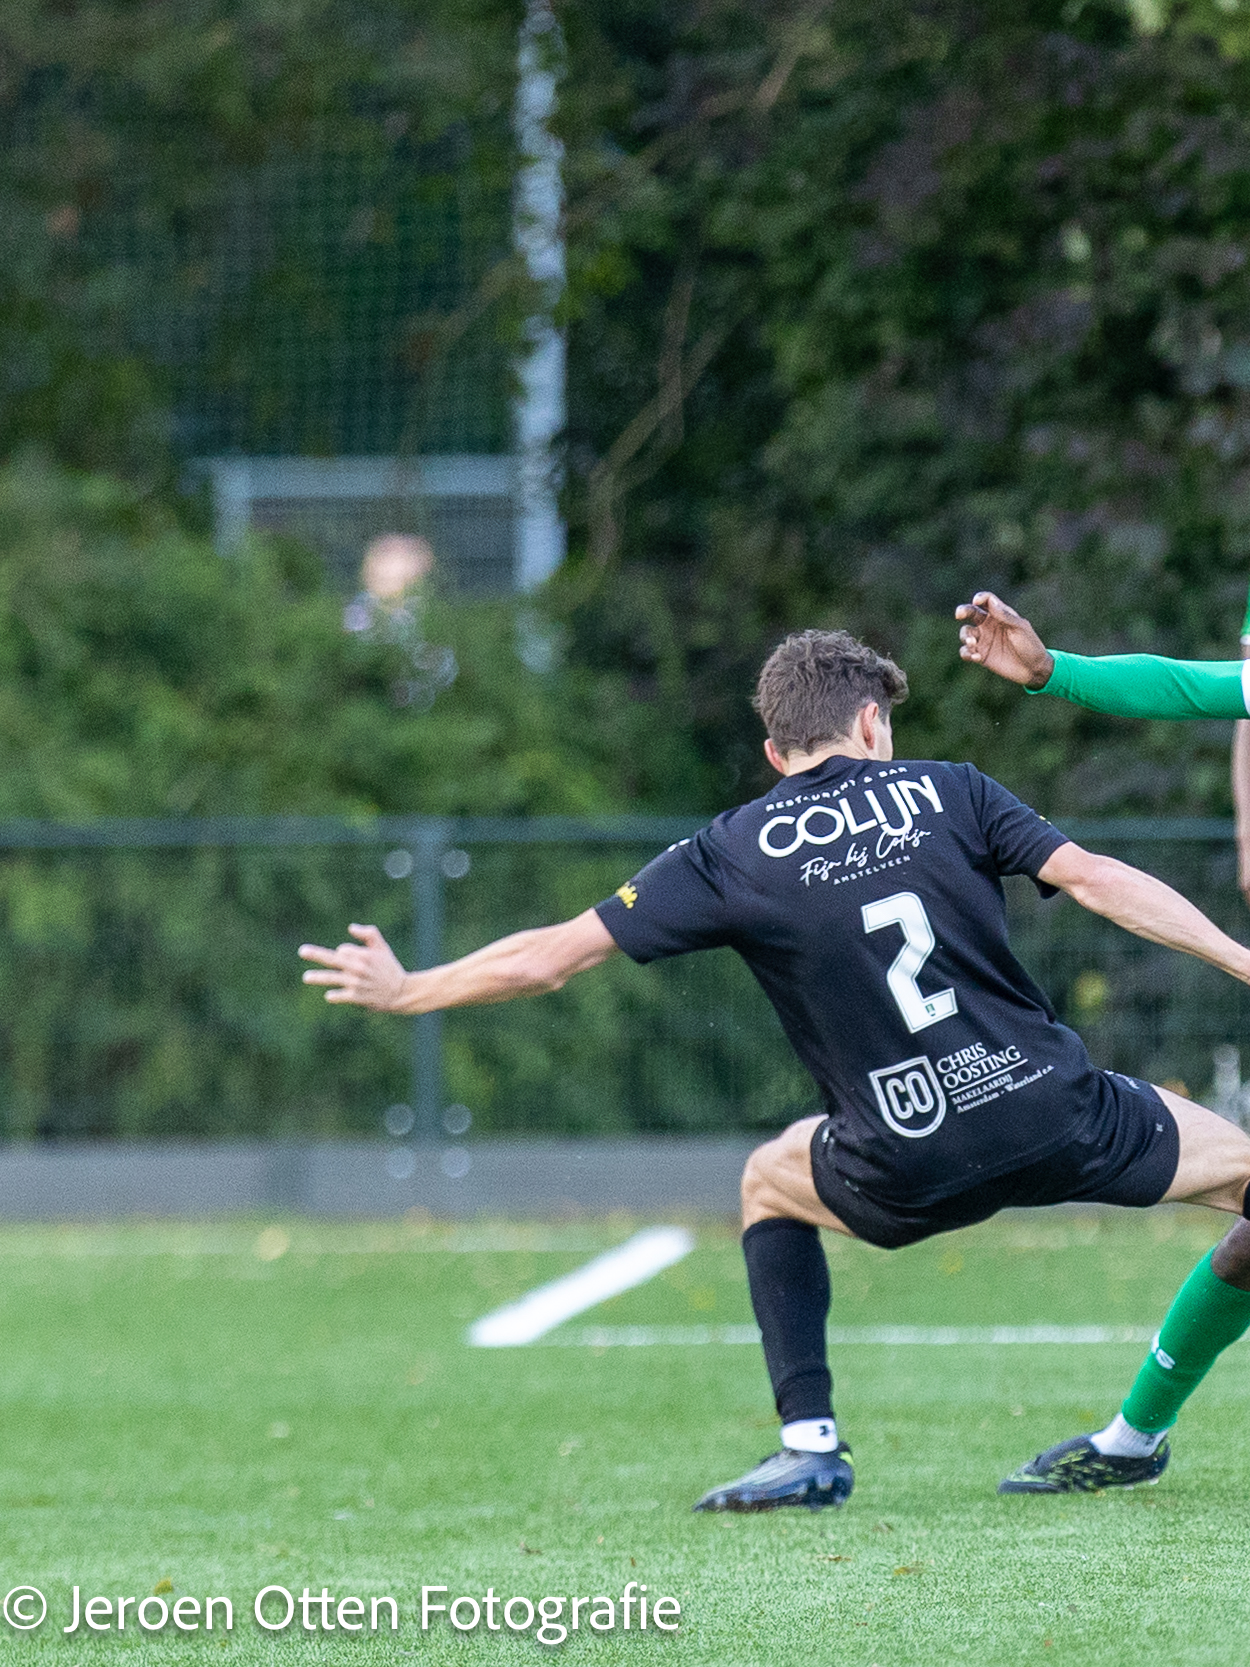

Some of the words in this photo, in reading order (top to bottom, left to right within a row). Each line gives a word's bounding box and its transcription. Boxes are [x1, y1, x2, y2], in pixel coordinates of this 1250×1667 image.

[833, 854, 911, 885] AMSTELVEEN
[845, 842, 868, 868] bij
[861, 891, 959, 1034] 2
[936, 1042, 987, 1074] CHRIS
[943, 1045, 1021, 1089] OOSTING
[886, 1071, 934, 1120] CO
[957, 1092, 1000, 1114] Amsterdam
